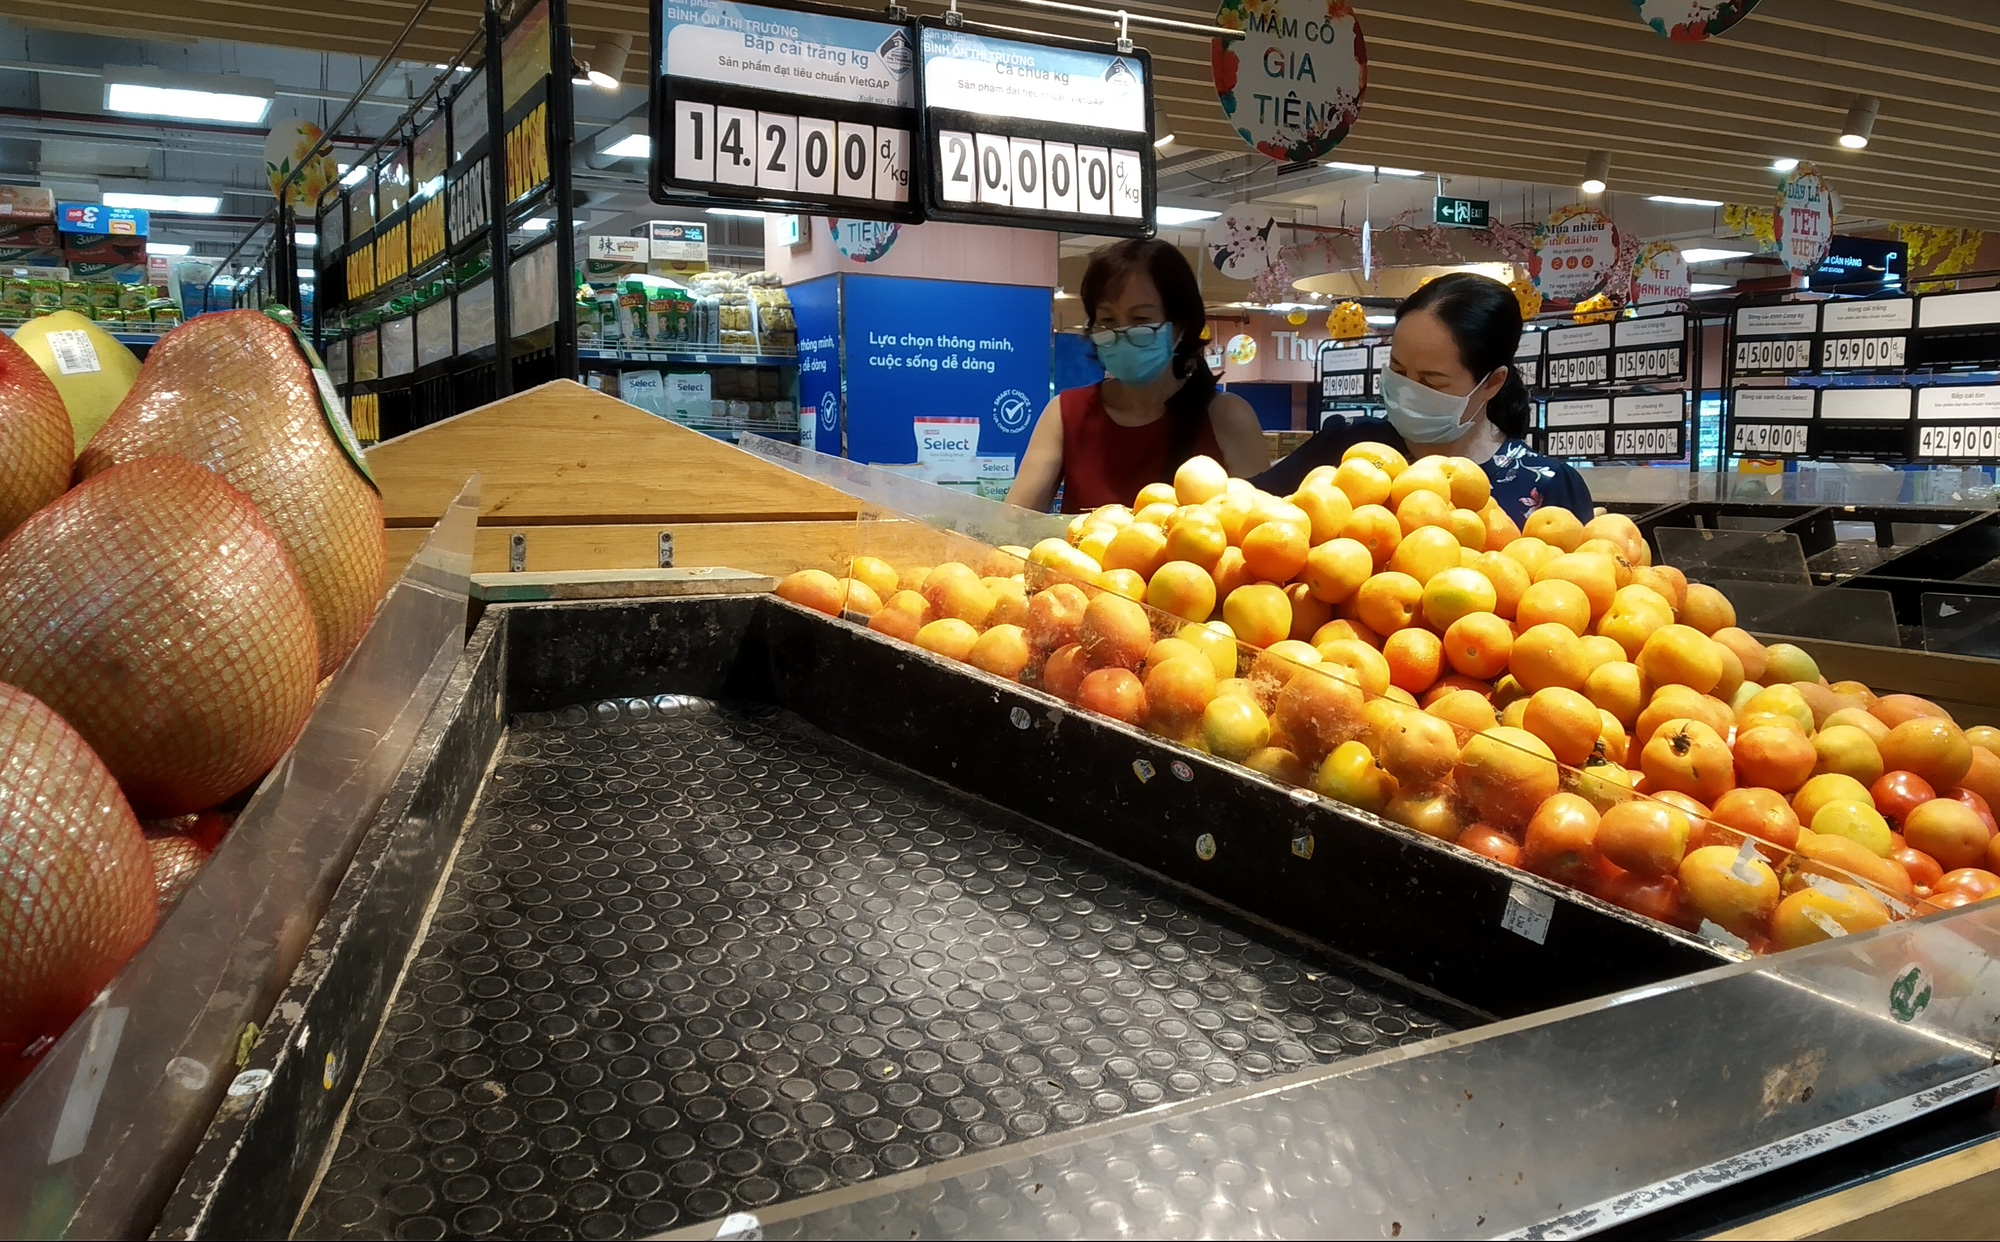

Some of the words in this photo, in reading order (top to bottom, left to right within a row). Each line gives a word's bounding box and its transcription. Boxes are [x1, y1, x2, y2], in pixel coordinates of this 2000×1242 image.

[744, 20, 799, 38] TRƯỜNG
[1249, 9, 1298, 39] MÂM
[852, 52, 869, 70] kg
[924, 40, 950, 54] BÌNH
[990, 49, 1035, 67] TRƯỜNG
[718, 55, 739, 69] Sản
[742, 57, 772, 75] phẩm
[773, 64, 791, 78] đạt
[793, 66, 813, 79] tiêu
[815, 68, 846, 84] chuẩn
[849, 75, 890, 90] VietGAP
[1263, 46, 1317, 83] GIA
[1018, 67, 1049, 80] chua
[1054, 70, 1069, 86] kg
[1253, 91, 1325, 132] TIÊN
[690, 111, 867, 181] 14.200
[83, 206, 99, 223] 3
[1471, 208, 1484, 219] EXIT
[1790, 202, 1821, 236] TẾT
[1545, 223, 1571, 235] Mua
[1654, 265, 1670, 280] TẾT
[800, 338, 818, 353] thông
[869, 331, 897, 349] Lựa
[900, 333, 934, 350] chọn
[937, 334, 976, 352] thông
[979, 336, 1014, 352] minh,
[1738, 344, 1795, 364] 45.000
[1824, 341, 1889, 362] 59.900
[869, 355, 902, 372] cuộc
[906, 354, 938, 372] sống
[942, 353, 958, 370] dễ
[962, 357, 996, 373] dàng
[1619, 352, 1667, 373] 15.900
[630, 379, 657, 388] Select
[677, 383, 704, 392] Select
[993, 389, 1011, 407] SMART
[1011, 389, 1032, 408] CHOICE
[924, 437, 970, 451] Select
[1550, 433, 1593, 451] 75.900
[1616, 432, 1665, 450] 75.900
[1736, 427, 1792, 447] 44.900
[1922, 430, 1993, 450] 42.900
[982, 463, 1010, 472] Select
